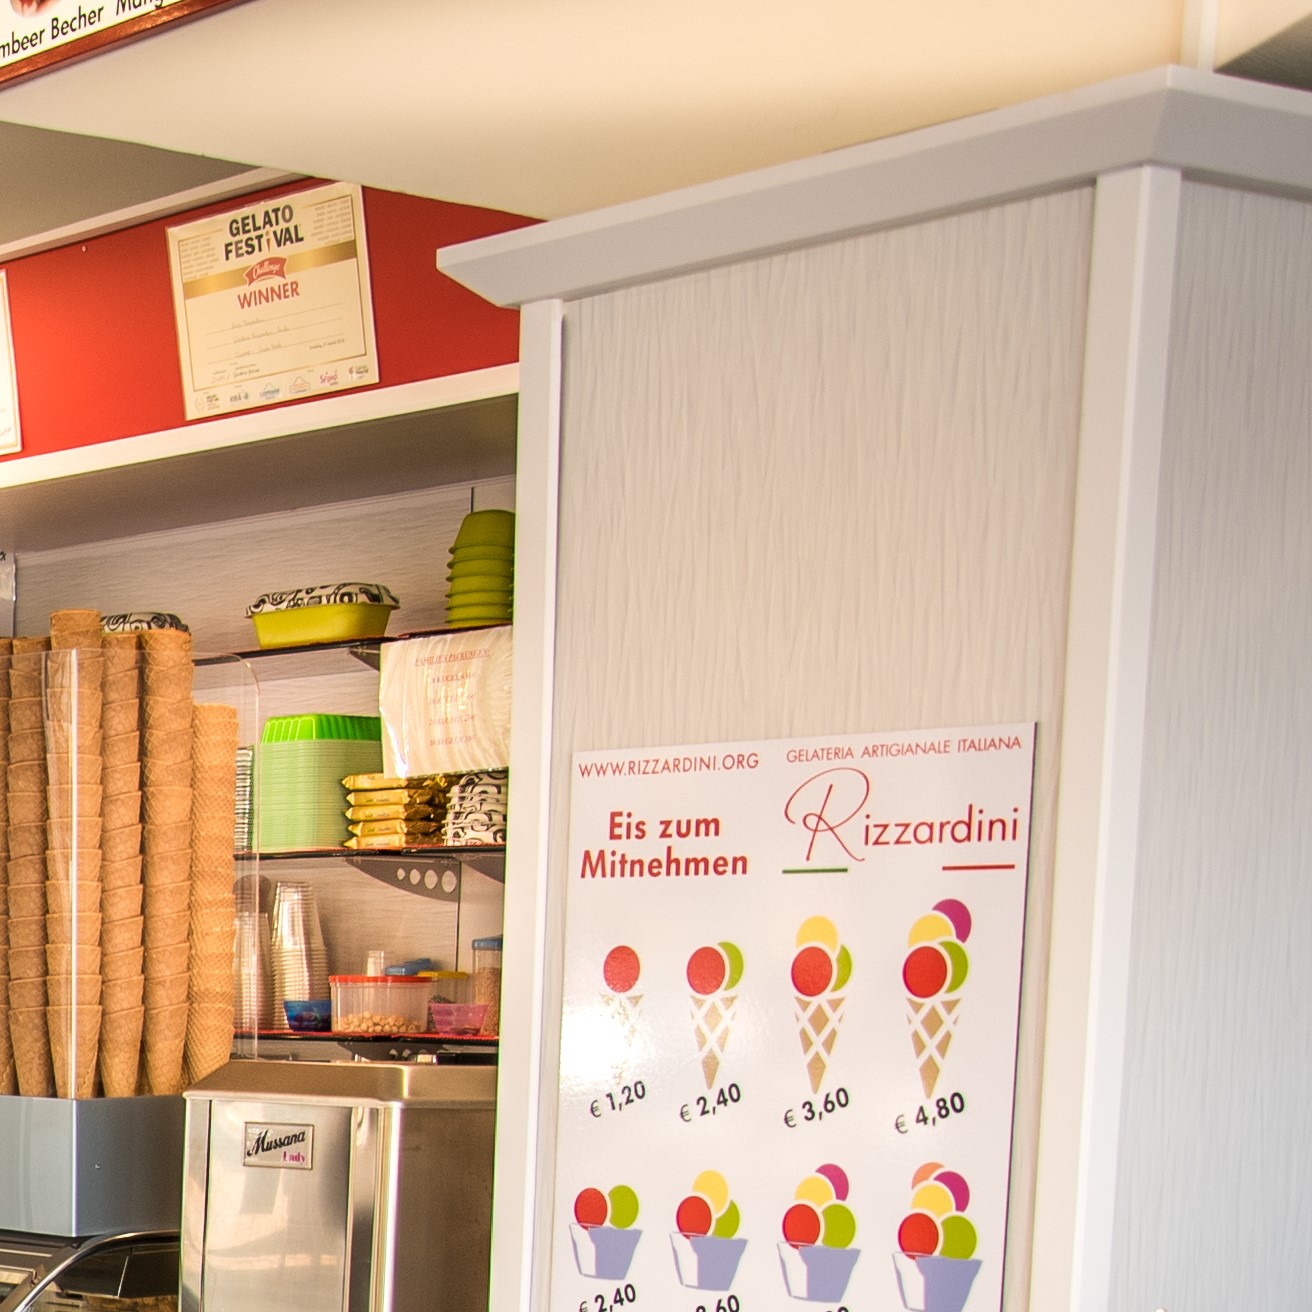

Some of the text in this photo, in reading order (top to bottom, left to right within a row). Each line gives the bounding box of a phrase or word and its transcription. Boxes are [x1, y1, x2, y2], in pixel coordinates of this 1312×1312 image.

[51, 0, 104, 39] Becher
[229, 205, 294, 237] GELATO
[238, 281, 300, 309] WINNER
[578, 752, 759, 778] WWW.RIZZARDINI.ORG
[786, 736, 1021, 763] GELATERIA ARTIGIANALE ITALIANA
[609, 811, 720, 841] Eis zum
[785, 767, 1019, 862] Rizzardini
[581, 846, 748, 879] Mitnehmen
[606, 1081, 647, 1113] 1,20
[697, 1084, 741, 1117] 2,40
[801, 1088, 850, 1123] 3,60
[915, 1092, 966, 1127] 4,80
[247, 1129, 305, 1156] Mussana
